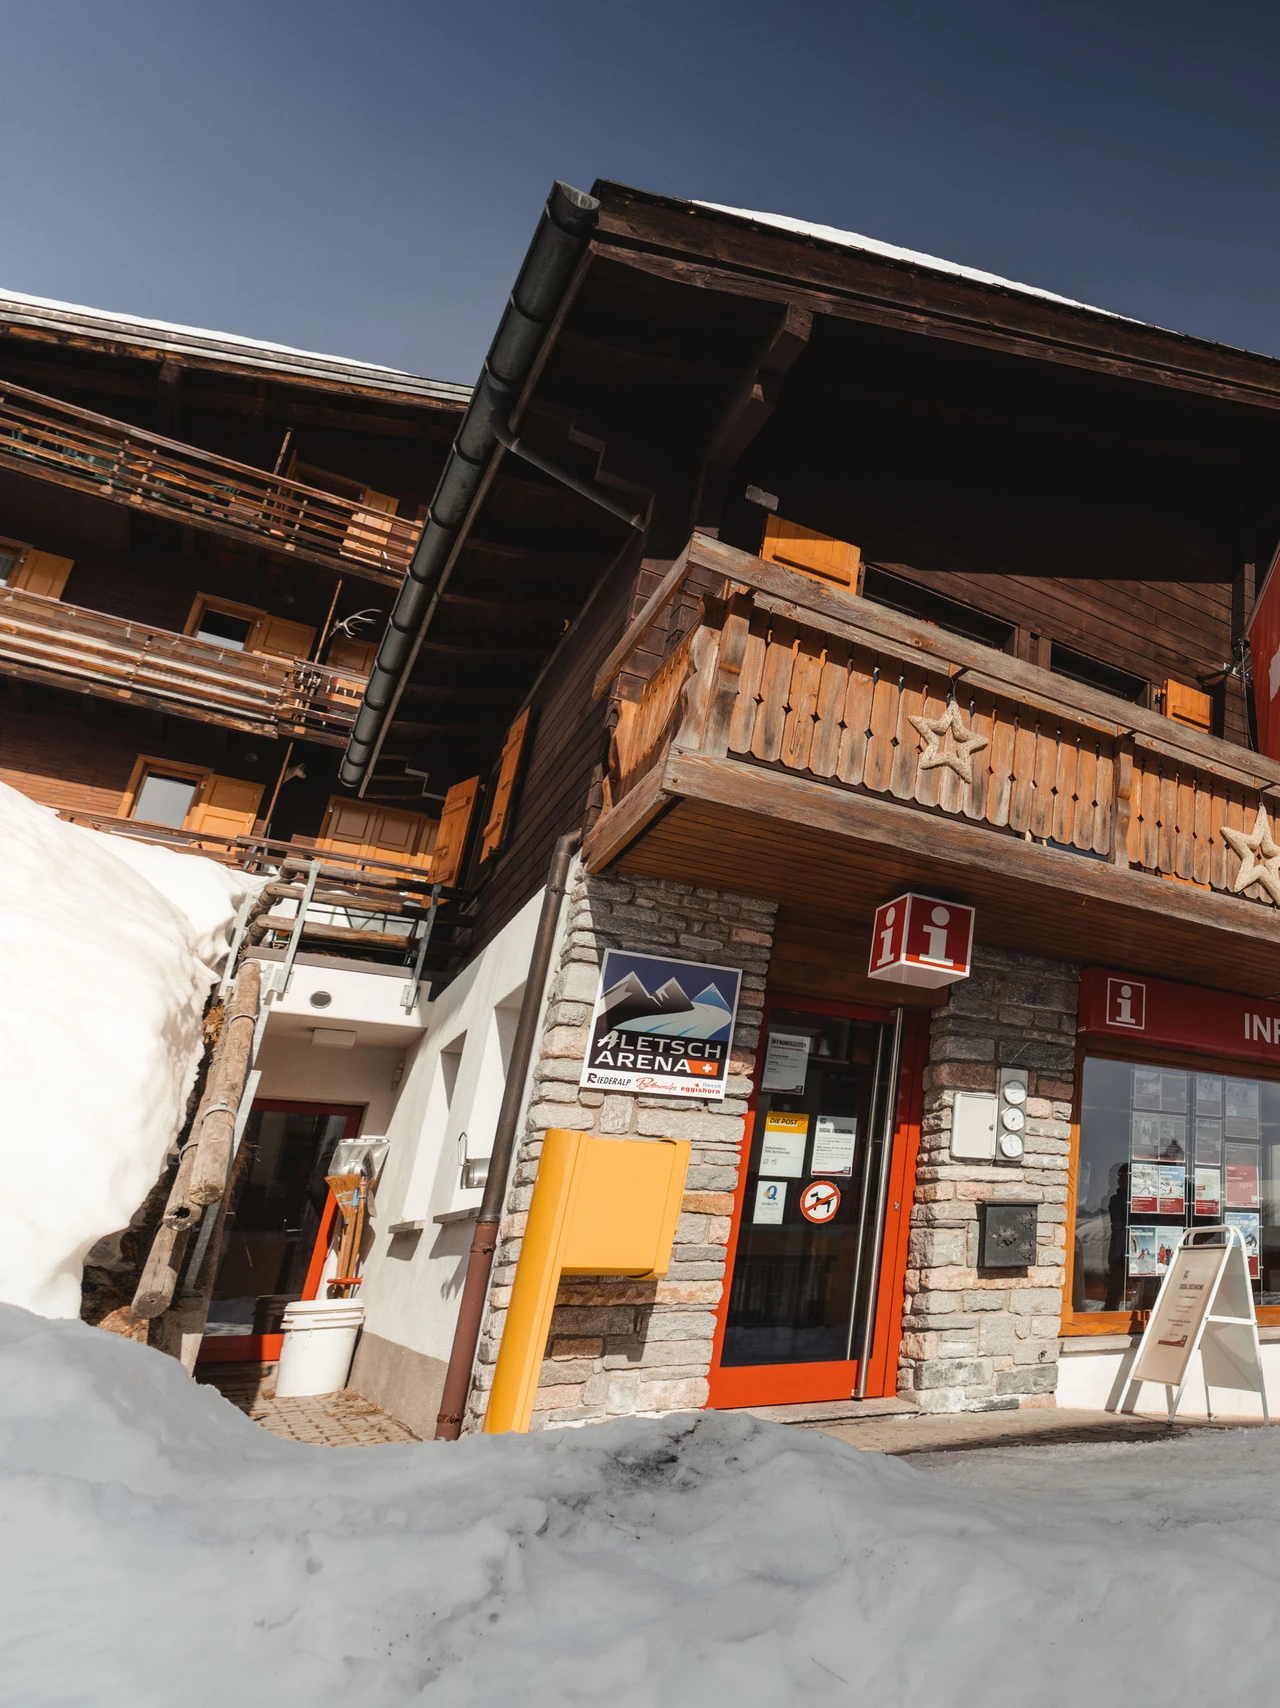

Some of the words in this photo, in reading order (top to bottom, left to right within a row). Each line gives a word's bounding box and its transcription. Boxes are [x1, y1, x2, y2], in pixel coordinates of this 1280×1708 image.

[597, 1030, 722, 1059] ALETSCH
[594, 1051, 692, 1074] ARENA
[586, 1072, 632, 1086] RIEDERALP
[680, 1086, 721, 1095] eggishorn
[769, 1117, 780, 1125] DIE
[780, 1118, 798, 1126] POST
